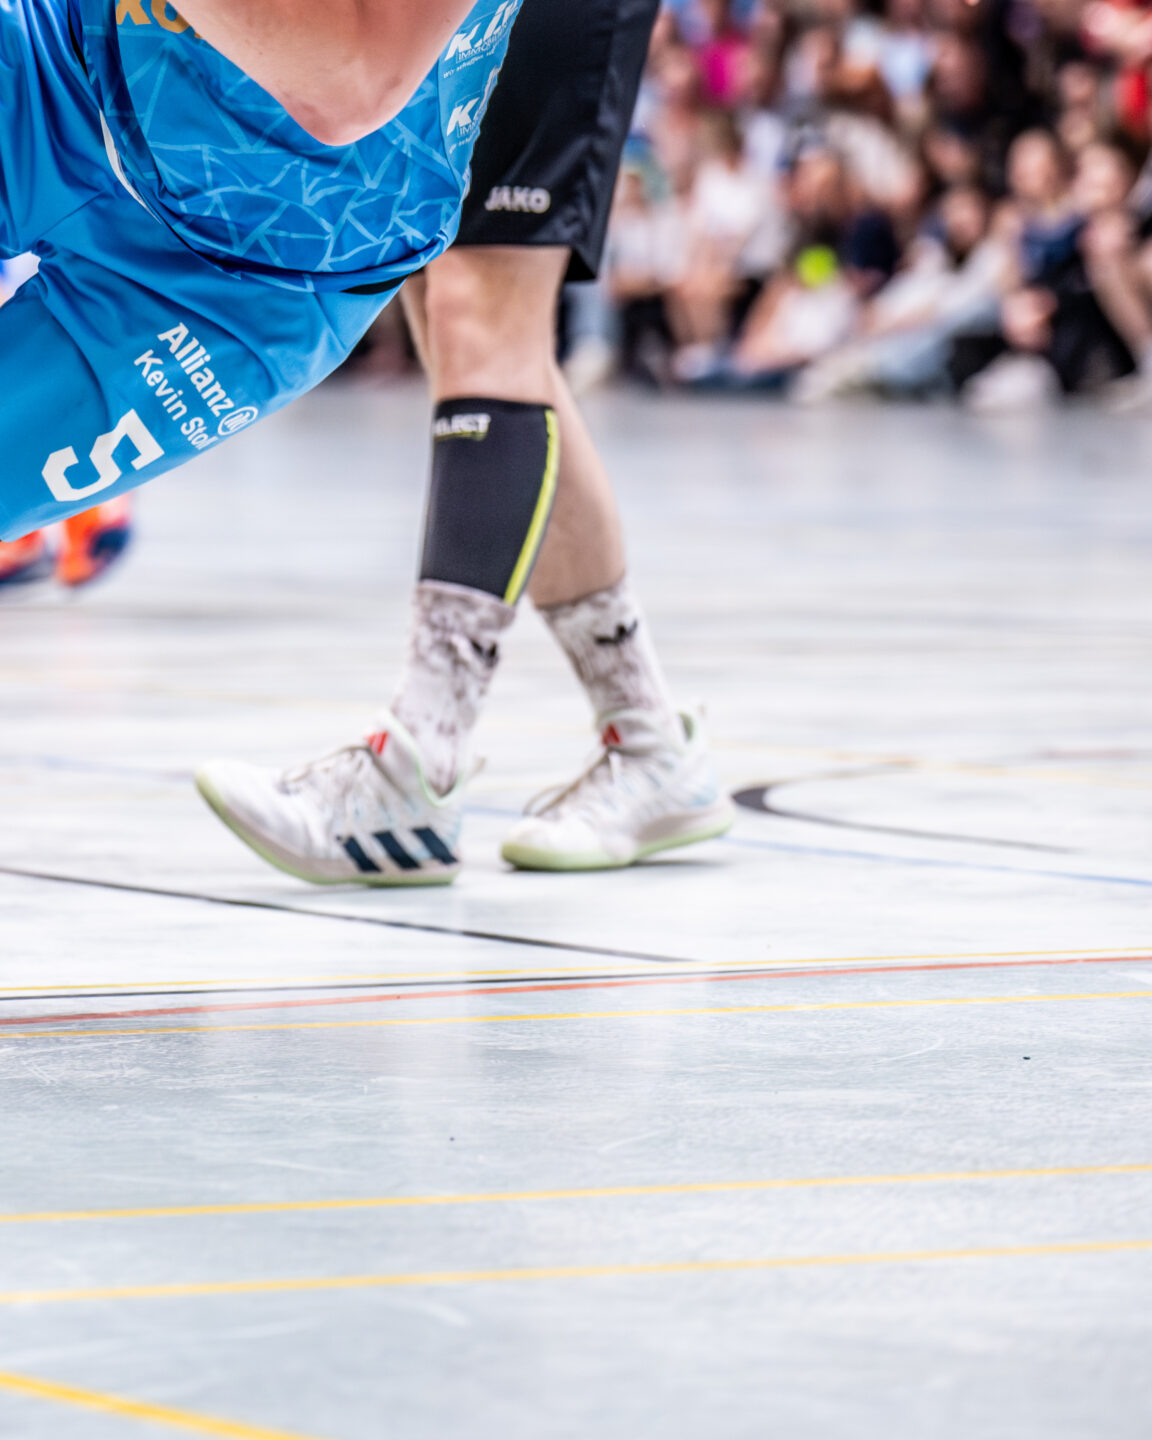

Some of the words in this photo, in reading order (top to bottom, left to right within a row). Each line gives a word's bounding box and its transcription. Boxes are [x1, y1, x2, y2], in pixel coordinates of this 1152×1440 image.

[485, 185, 551, 214] JAKO
[133, 349, 188, 421] Kevin
[157, 322, 235, 417] Allianz
[41, 408, 165, 502] 5
